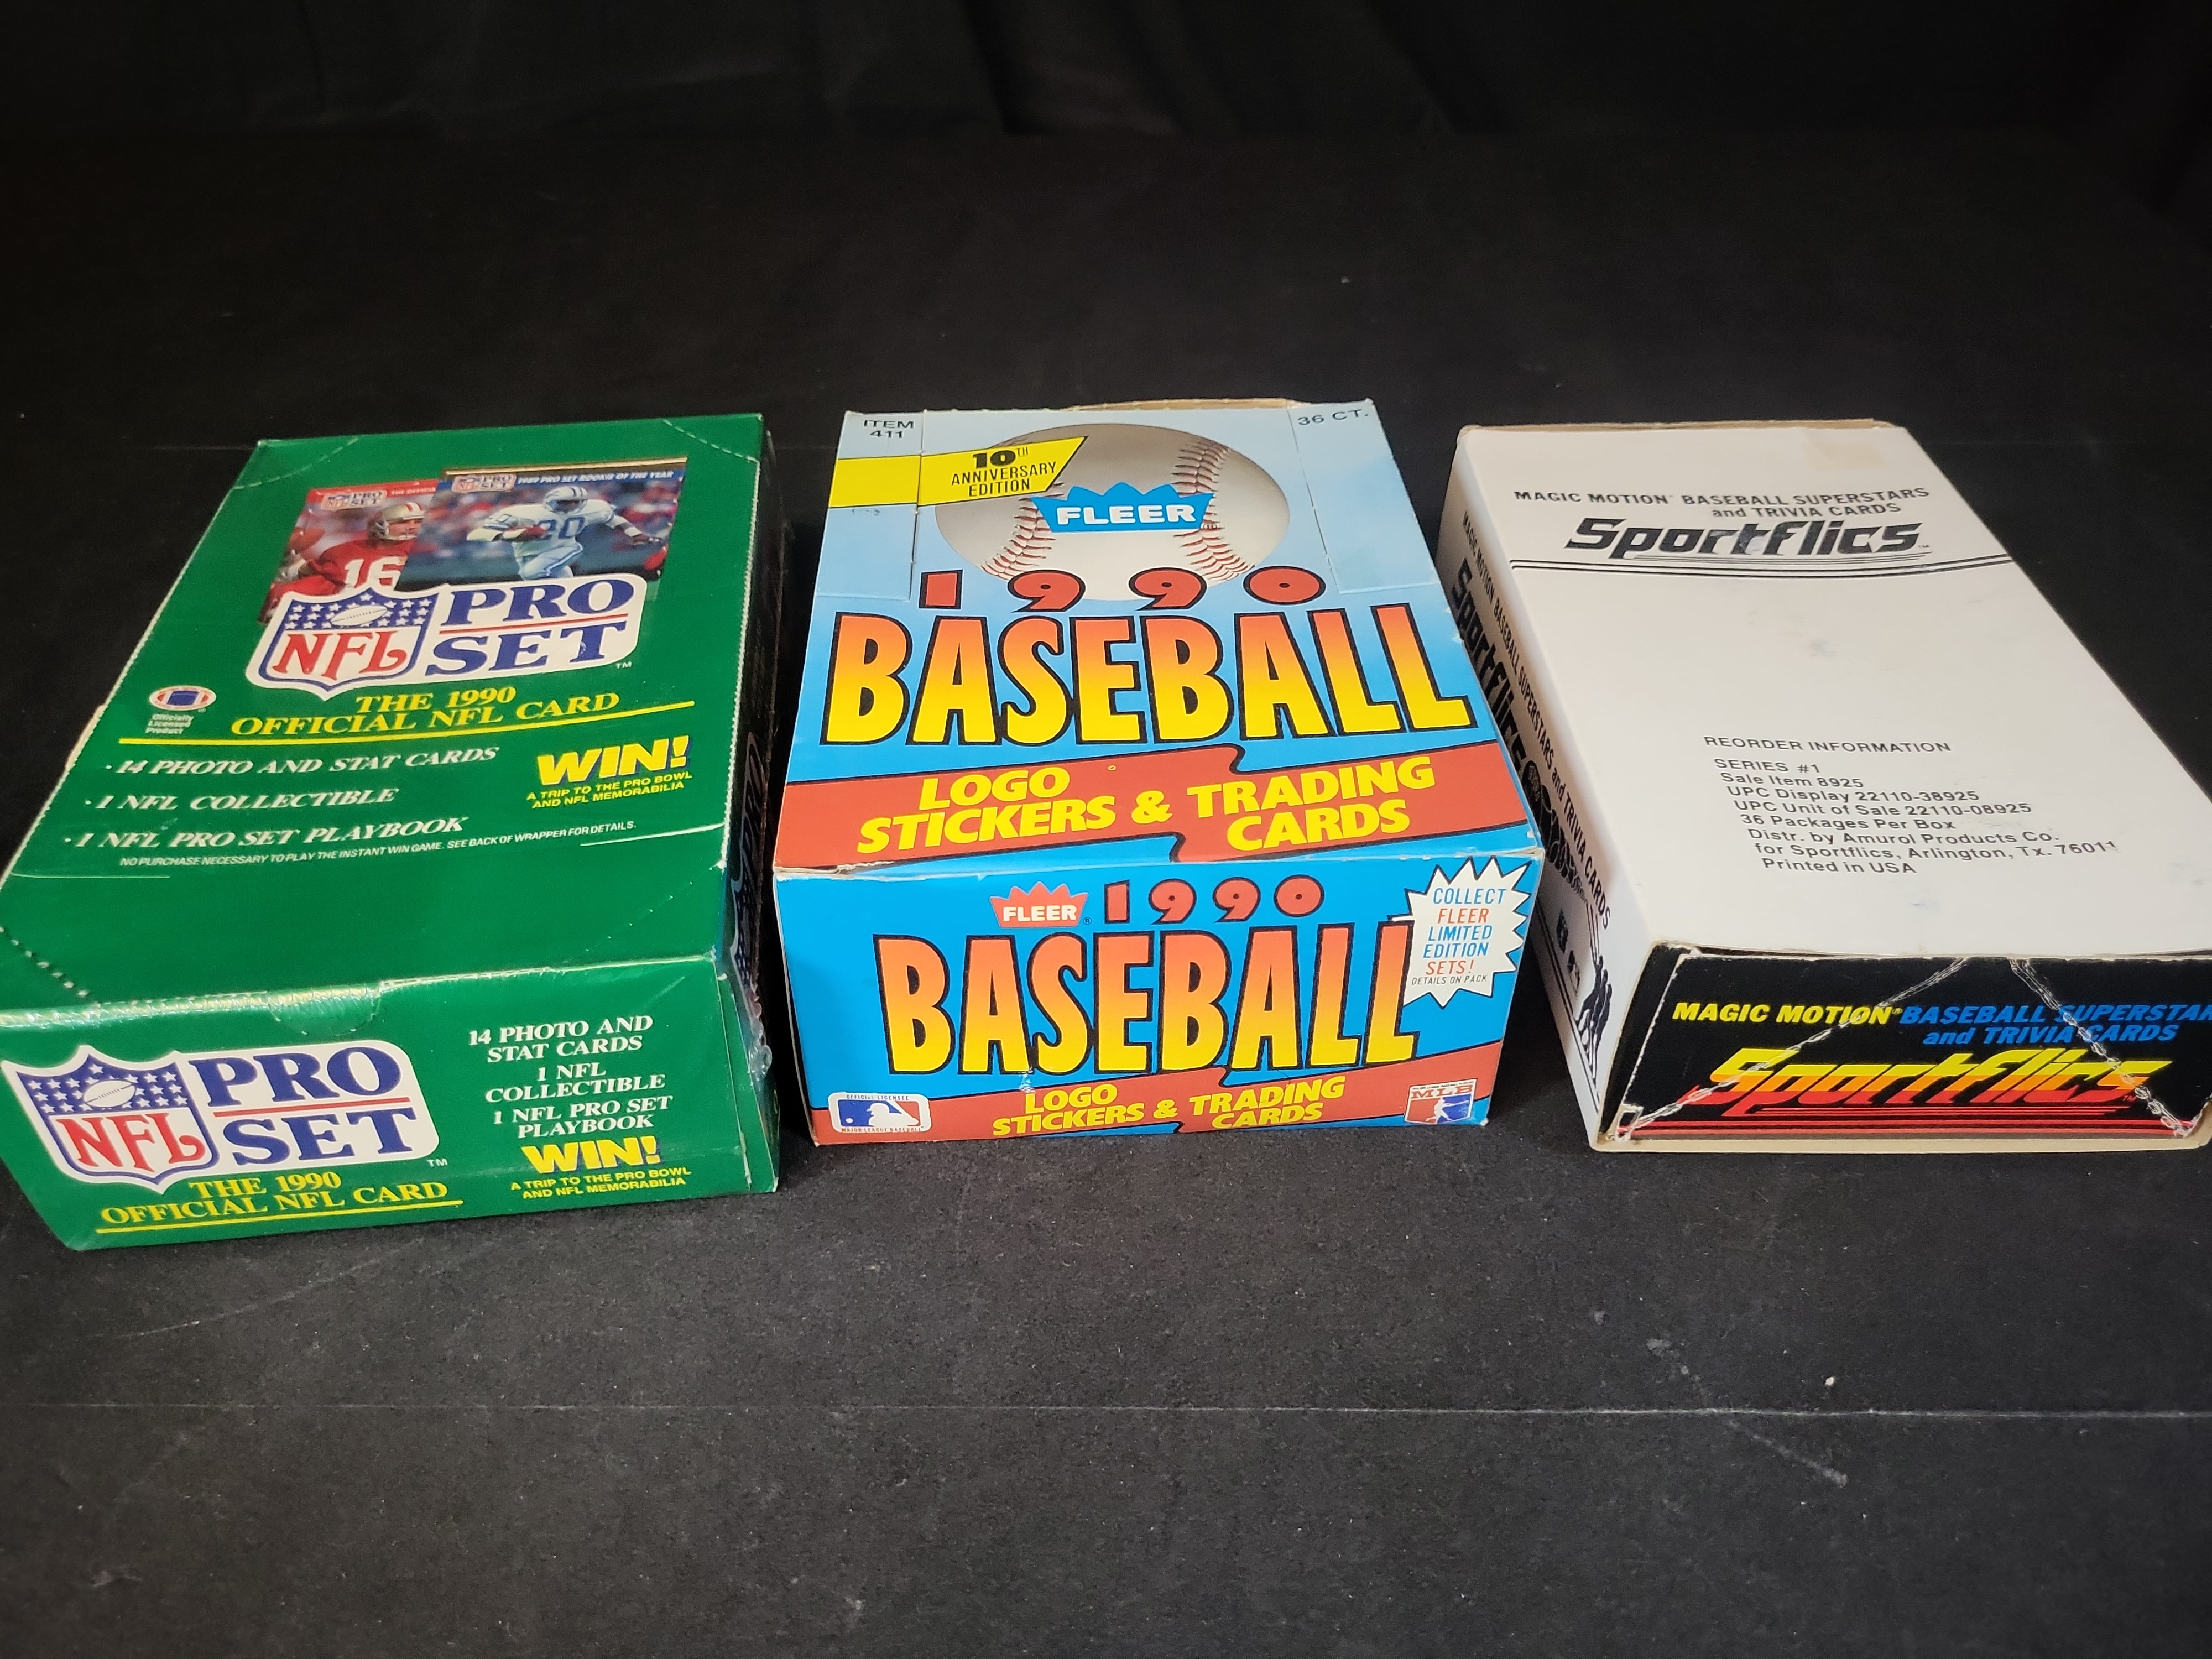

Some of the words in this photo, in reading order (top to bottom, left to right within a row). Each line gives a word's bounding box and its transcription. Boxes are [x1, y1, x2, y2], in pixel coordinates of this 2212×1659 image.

[863, 420, 915, 429] ITEM
[1297, 414, 1324, 426] 36
[1331, 409, 1369, 421] CT.
[870, 430, 904, 439] 411
[972, 447, 1029, 469] 10TH
[951, 461, 1057, 486] ANNIVERSARY
[968, 478, 1030, 497] EDITION
[1514, 491, 1582, 503] MAGIC
[1587, 494, 1669, 505] MOTION
[1682, 495, 1789, 505] BASEBALL
[1793, 488, 1929, 505] SUPERSTARS
[1056, 504, 1195, 525] FLEER
[1712, 508, 1746, 518] and
[1751, 507, 1823, 517] TRIVIA
[1829, 503, 1901, 517] CARDS
[1563, 518, 1923, 559] Sportflics
[441, 579, 634, 625] PRO
[272, 630, 407, 680] NFL
[425, 620, 629, 677] SET
[820, 603, 1478, 747] BASEBALL
[1452, 558, 1527, 771] Sportflics
[354, 692, 433, 713] THE
[445, 686, 516, 708] 1990
[231, 713, 416, 735] OFFICIAL
[429, 706, 504, 728] NFL
[515, 692, 619, 721] CARD
[1462, 510, 1478, 557] MAGIC
[1475, 549, 1495, 603] MOTION
[1494, 598, 1519, 675] BASEBALL
[1518, 669, 1554, 771] SUPERSTARS
[1564, 792, 1585, 864] TRIVIA
[1584, 857, 1610, 930] CARDS
[1703, 737, 1803, 750] REORDER
[1808, 741, 1952, 753] INFORMATION
[148, 760, 253, 774] PHOTO
[258, 759, 323, 773] AND
[330, 753, 401, 771] STAT
[405, 746, 500, 766] CARDS
[537, 735, 690, 785] WIN!
[1714, 759, 1788, 772] SERIES
[1797, 764, 1820, 773] #1
[624, 778, 651, 789] PRO
[654, 771, 693, 782] BOWL
[919, 766, 1071, 810] LOGO
[1187, 757, 1436, 818] TRADING
[1720, 773, 1764, 784] Sale
[1768, 775, 1813, 786] Item
[1818, 777, 1864, 788] 8925
[117, 795, 178, 810] NFL
[190, 788, 400, 810] COLLECTIBLE
[531, 799, 561, 809] AND
[593, 781, 685, 802] MEMORABILIA
[1727, 786, 1770, 797] UPC
[1775, 788, 1849, 802] Display
[1855, 791, 1979, 802] 22110-38925
[1733, 800, 1777, 812] UPC
[1782, 802, 1825, 814] Unit
[1831, 805, 1850, 814] of
[1854, 805, 1901, 816] Sale
[1905, 803, 2032, 816] 22110-08925
[98, 833, 160, 847] NFL
[168, 832, 234, 848] PRO
[238, 829, 301, 847] SET
[302, 817, 470, 843] PLAYBOOK
[857, 796, 1116, 853] STICKERS
[1131, 790, 1172, 824] &
[1227, 799, 1411, 851] CARDS
[1740, 814, 1765, 825] 36
[1770, 815, 1869, 831] Packages
[1873, 819, 1907, 829] Per
[1913, 818, 1957, 830] Box
[139, 857, 200, 865] PURCHASE
[201, 855, 269, 865] NECESSARY
[338, 847, 386, 858] INSTANT
[411, 842, 444, 853] GAME.
[469, 837, 499, 847] BACK
[514, 830, 567, 843] WRAPPER
[590, 821, 637, 834] DETAILS.
[1747, 828, 1804, 842] Distr.
[1810, 832, 1834, 845] by
[1843, 833, 1916, 844] Amurol
[1921, 833, 2017, 844] Products
[2022, 831, 2059, 842] Co.
[1754, 843, 1783, 854] for
[1790, 844, 1902, 859] Sportflics,
[1908, 847, 2013, 860] Arlington,
[2015, 846, 2052, 857] Tx.
[1762, 858, 1839, 872] Printed
[1844, 862, 1865, 873] in
[1867, 862, 1917, 873] USA
[1104, 875, 1324, 924] 1990
[1433, 888, 1506, 905] COLLECT
[1003, 905, 1077, 922] FLEER
[1438, 908, 1489, 924] FLEER
[1428, 925, 1492, 941] LIMITED
[1423, 942, 1489, 958] EDITION
[1411, 977, 1446, 985] DETAILS
[1464, 974, 1488, 983] PACK
[1426, 960, 1474, 975] SETS!
[873, 921, 1420, 1075] BASEBALL
[1672, 1002, 1770, 1023] MAGIC
[1899, 1005, 2046, 1025] BASEBALL
[469, 1029, 491, 1045] 14
[499, 1021, 589, 1043] PHOTO
[597, 1015, 653, 1035] AND
[1922, 1028, 1976, 1045] and
[1984, 1026, 2077, 1044] TRIVIA
[2078, 1024, 2179, 1043] CARDS
[487, 1043, 549, 1062] STAT
[556, 1035, 643, 1057] CARDS
[189, 1047, 402, 1107] PRO
[556, 1062, 607, 1079] NFL
[1677, 1048, 2173, 1116] Sportflics
[485, 1074, 666, 1103] COLLECTIBLE
[1025, 1083, 1118, 1113] LOGO
[1189, 1077, 1346, 1113] TRADING
[1411, 1085, 1473, 1099] MLB
[513, 1106, 562, 1123] NFL
[570, 1100, 621, 1118] PRO
[627, 1096, 673, 1113] SET
[993, 1103, 1144, 1135] STICKERS
[1154, 1099, 1178, 1118] &
[1212, 1103, 1323, 1129] CARDS
[223, 1108, 418, 1166] SET
[518, 1114, 655, 1138] PLAYBOOK
[57, 1113, 205, 1173] NFL
[521, 1135, 661, 1174] WIN!
[189, 1177, 267, 1199] THE
[275, 1172, 341, 1192] 1990
[523, 1189, 552, 1198] AND
[556, 1186, 584, 1196] NFL
[587, 1177, 686, 1193] MEMORABILIA
[524, 1178, 556, 1188] TRIP
[560, 1176, 581, 1186] TO
[585, 1173, 612, 1183] THE
[615, 1170, 645, 1181] PRO
[649, 1167, 692, 1177] BOWL
[101, 1197, 268, 1224] OFFICIAL
[273, 1191, 345, 1211] NFL
[353, 1182, 448, 1204] CARD
